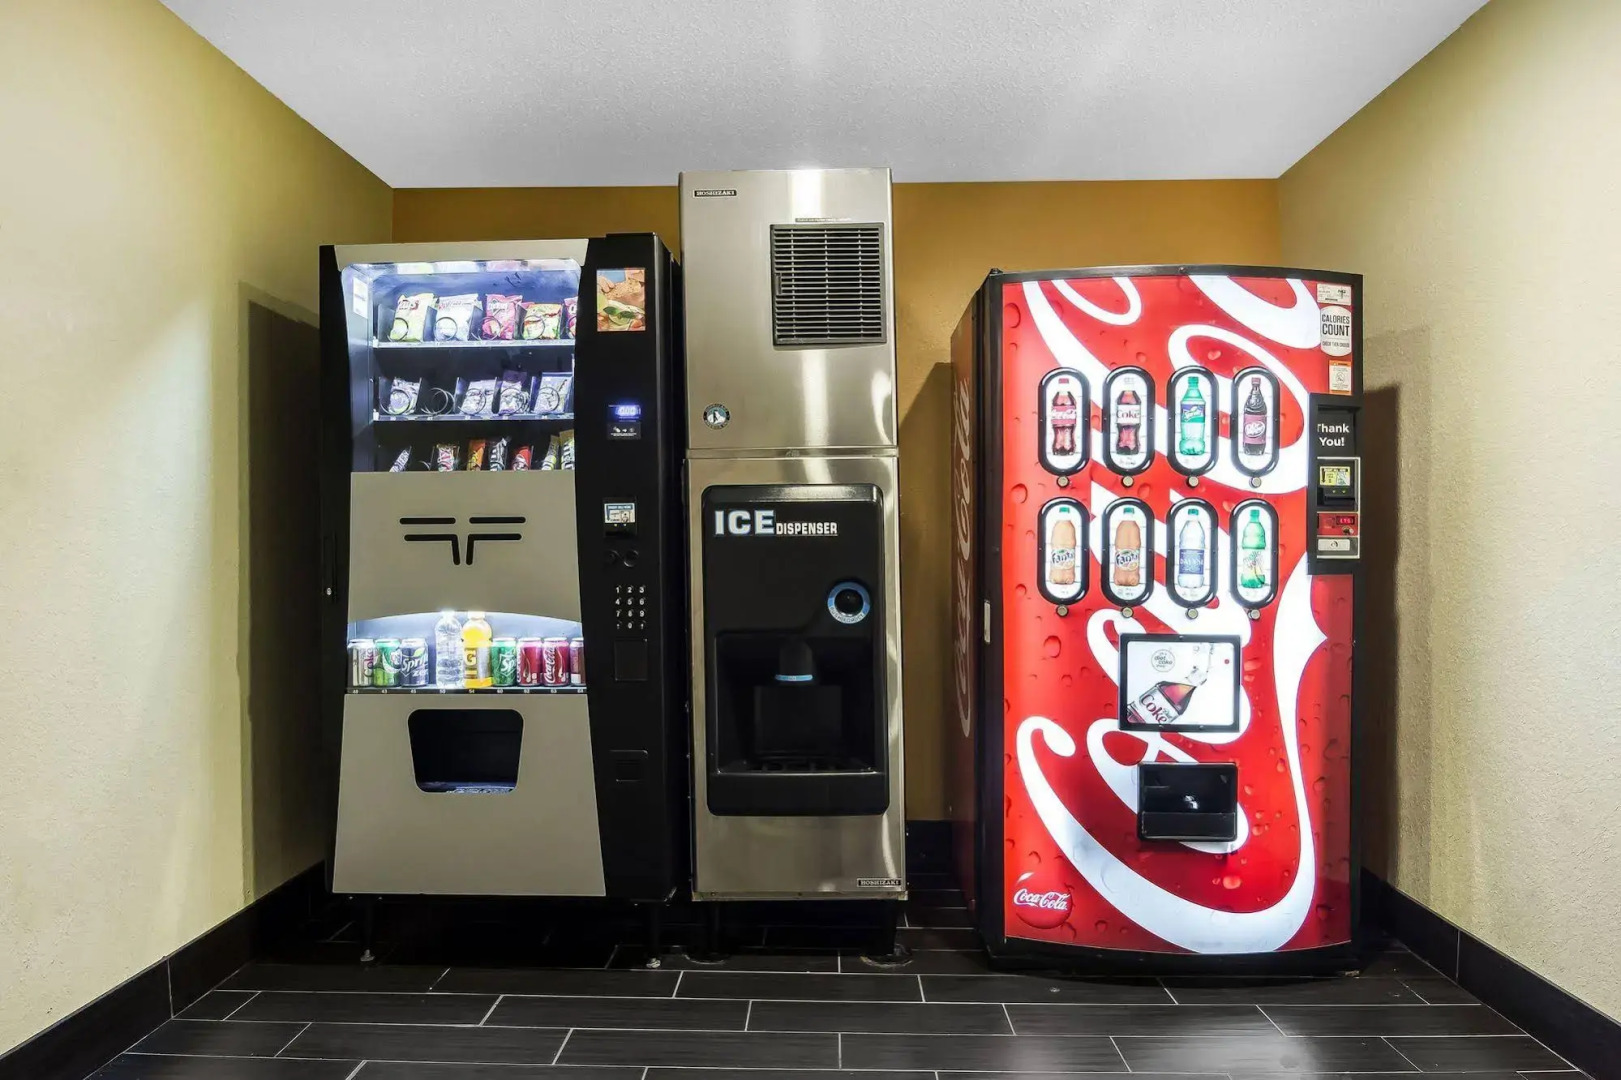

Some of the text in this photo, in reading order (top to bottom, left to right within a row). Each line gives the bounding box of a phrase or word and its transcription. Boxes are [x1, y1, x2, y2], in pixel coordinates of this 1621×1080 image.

[1322, 314, 1350, 324] CALORIES
[1322, 323, 1350, 337] COUNT
[1116, 409, 1140, 419] Coke
[1316, 423, 1350, 433] Thank
[1319, 437, 1345, 447] You!
[714, 509, 776, 536] ICE
[776, 521, 839, 536] DISPENSER
[616, 586, 645, 594] 1 2 3
[639, 598, 645, 606] 6
[628, 609, 633, 617] 8
[639, 609, 645, 617] 9
[363, 648, 374, 677] Coke
[1141, 694, 1167, 724] Coke
[1013, 887, 1071, 911] Coca-Cola
